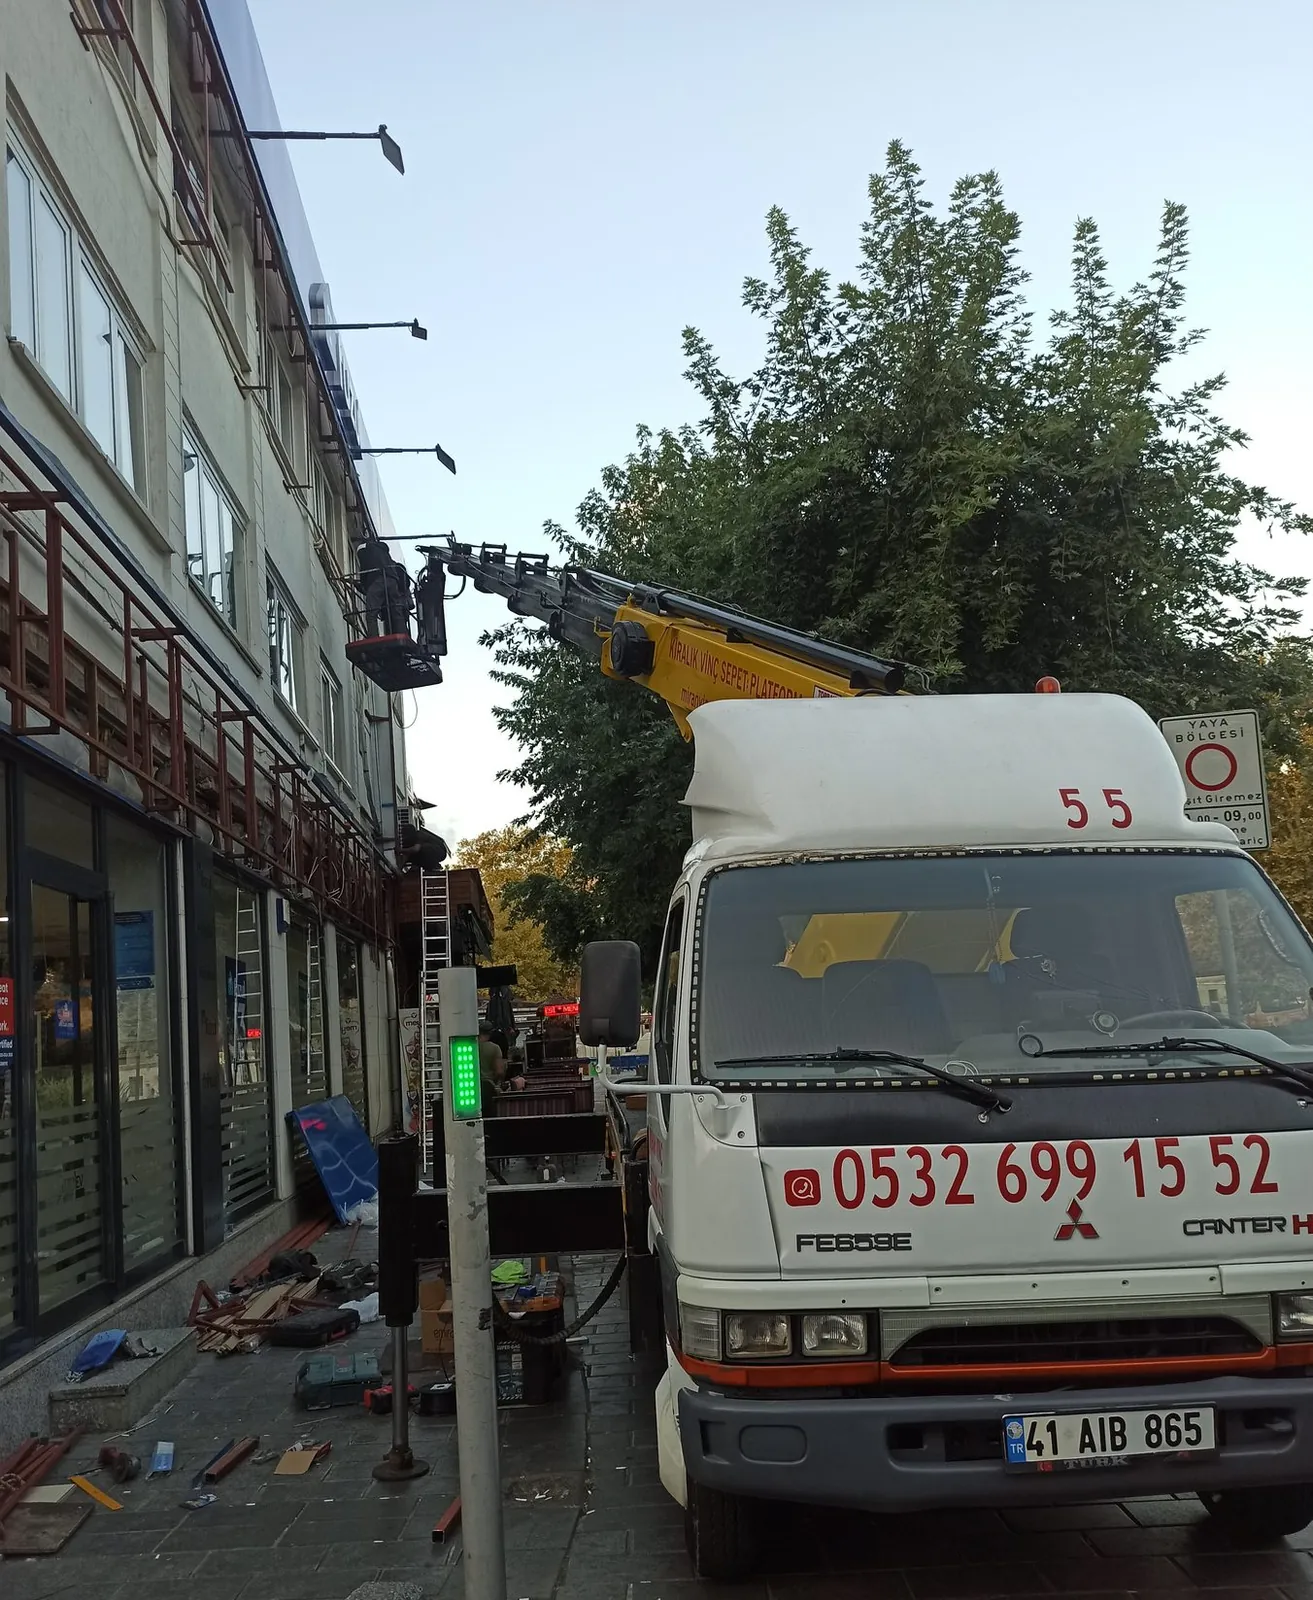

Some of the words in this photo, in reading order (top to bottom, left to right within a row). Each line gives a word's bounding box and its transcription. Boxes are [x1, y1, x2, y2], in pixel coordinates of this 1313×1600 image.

[700, 650, 719, 685] VİNÇ
[1188, 718, 1229, 729] YAYA
[1175, 727, 1244, 743] BÖLGESİ
[1205, 793, 1262, 804] Giremez
[1224, 810, 1262, 823] 09,00
[1239, 837, 1263, 846] ariç
[833, 1144, 975, 1210] 0532
[996, 1140, 1097, 1203] 699
[1123, 1137, 1186, 1198] 15
[1208, 1134, 1279, 1196] 52
[1182, 1216, 1287, 1236] CANTER
[796, 1232, 913, 1253] FE659E
[1026, 1420, 1059, 1457] 41
[1079, 1416, 1127, 1454] AIB
[1145, 1412, 1201, 1449] 865
[1010, 1443, 1024, 1455] TR
